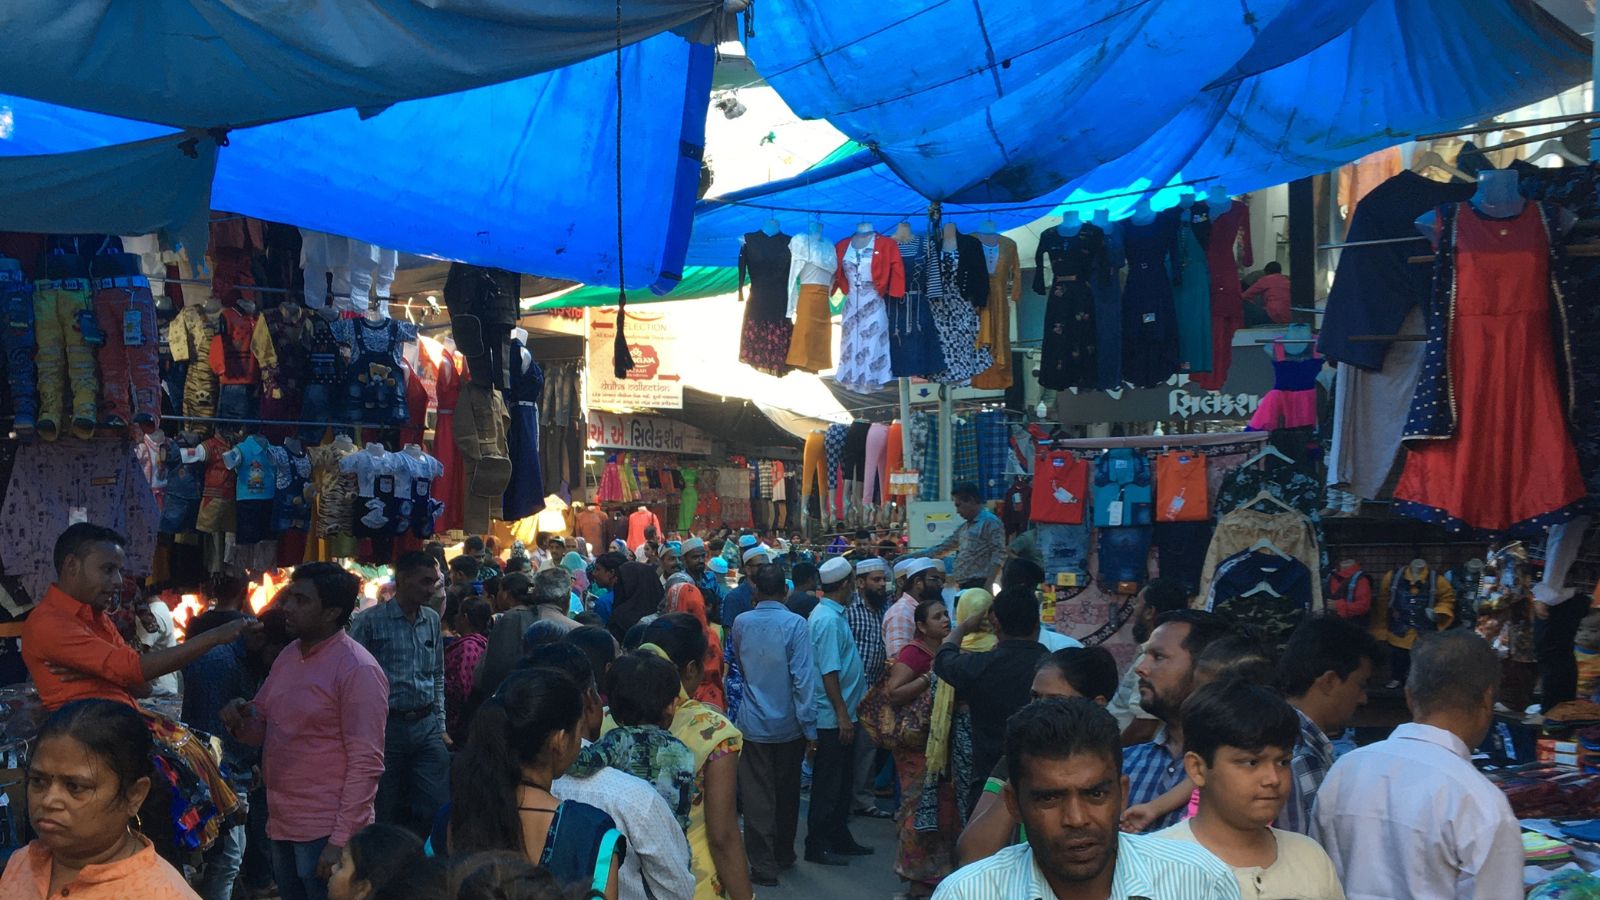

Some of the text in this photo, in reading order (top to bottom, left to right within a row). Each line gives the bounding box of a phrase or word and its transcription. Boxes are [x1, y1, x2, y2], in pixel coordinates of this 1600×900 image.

[623, 322, 667, 331] ELECTION
[628, 382, 671, 392] collection
[1169, 389, 1262, 418] સિલેકશ
